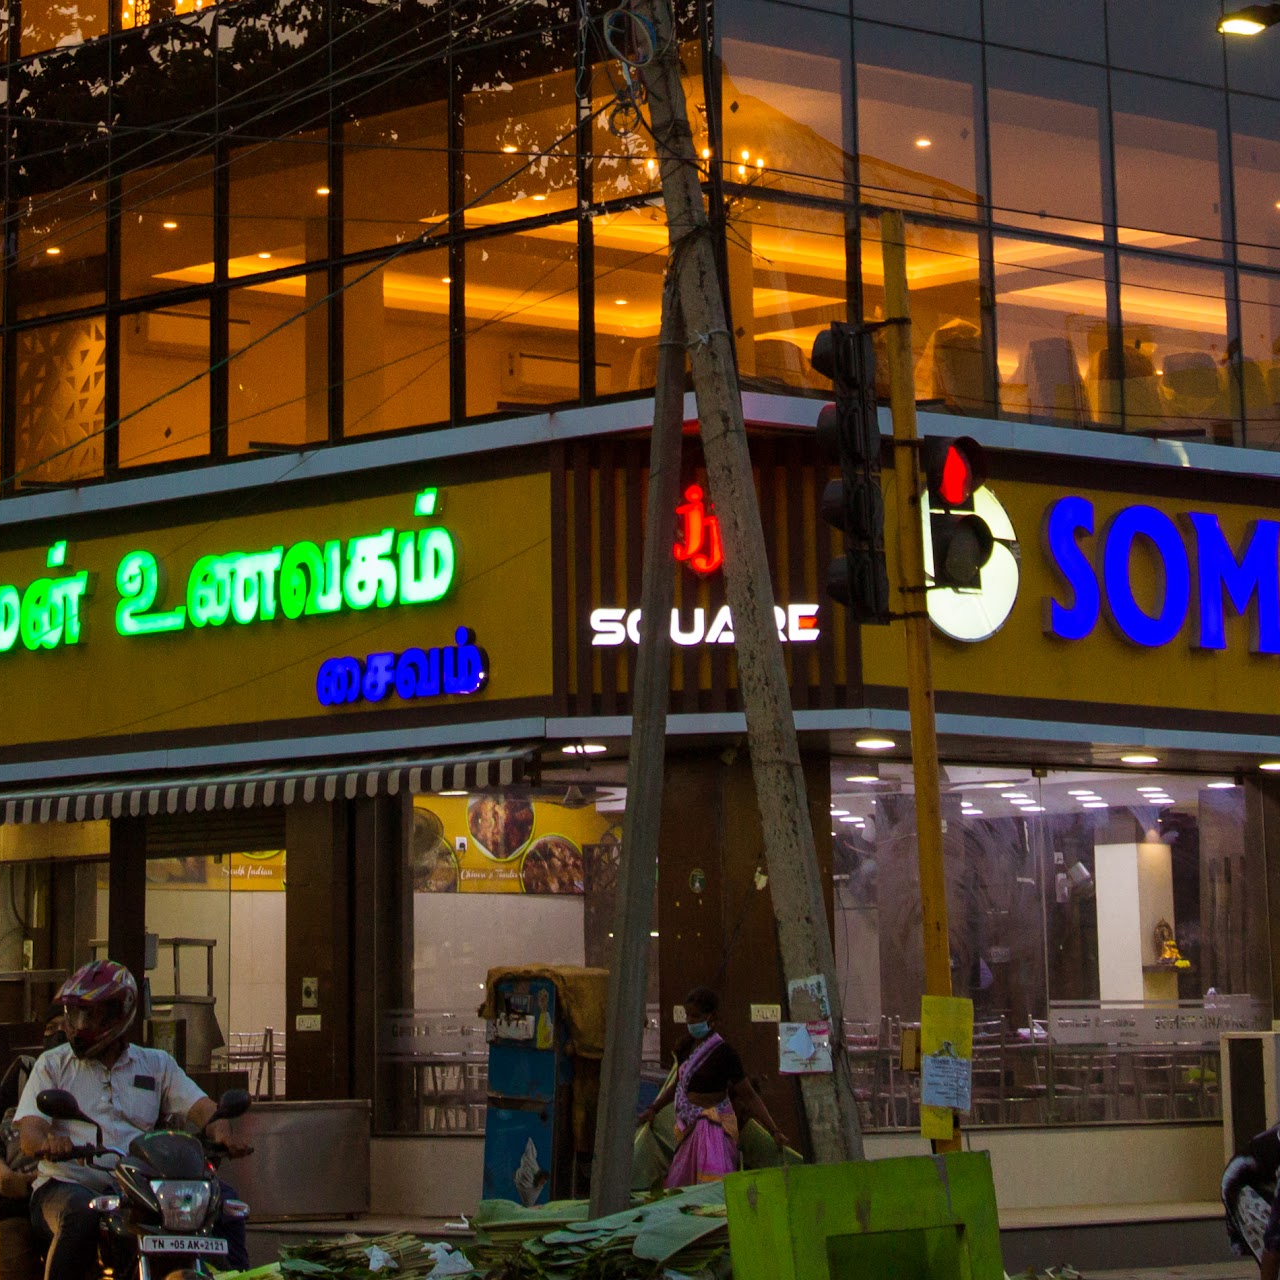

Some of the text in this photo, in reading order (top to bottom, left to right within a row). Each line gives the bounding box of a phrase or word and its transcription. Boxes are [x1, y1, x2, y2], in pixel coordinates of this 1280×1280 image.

[115, 487, 455, 635] உணவகம்
[317, 626, 488, 706] சைவம்
[152, 1240, 165, 1249] TN
[204, 1241, 224, 1251] 2121
